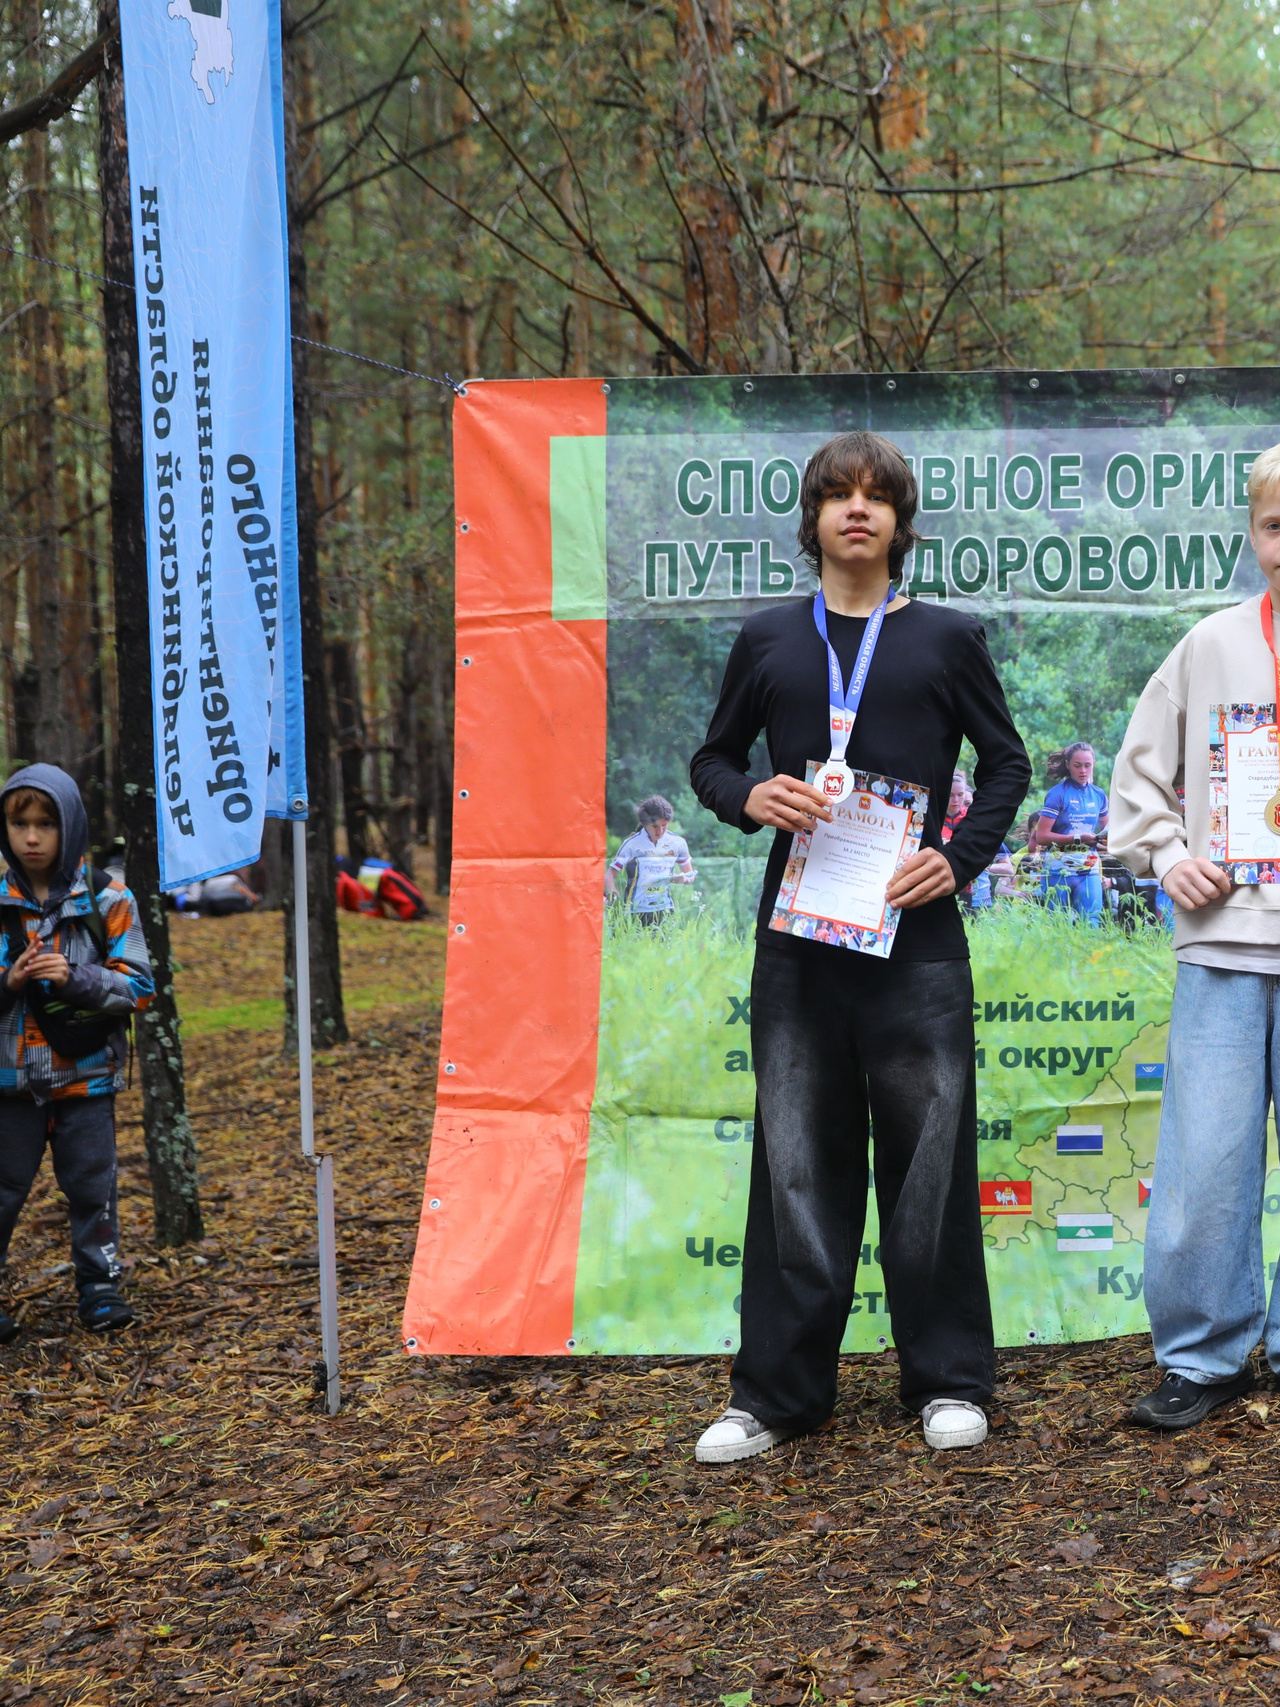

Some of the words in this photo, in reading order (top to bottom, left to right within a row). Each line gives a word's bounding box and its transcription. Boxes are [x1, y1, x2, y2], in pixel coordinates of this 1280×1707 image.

[676, 453, 1083, 516] СПОВНОЕ
[645, 540, 795, 599] ПУТЬ
[893, 532, 1245, 603] ДОРОВОМУ
[852, 656, 868, 695] ОБЛАСТЬ
[998, 1043, 1113, 1076] округ
